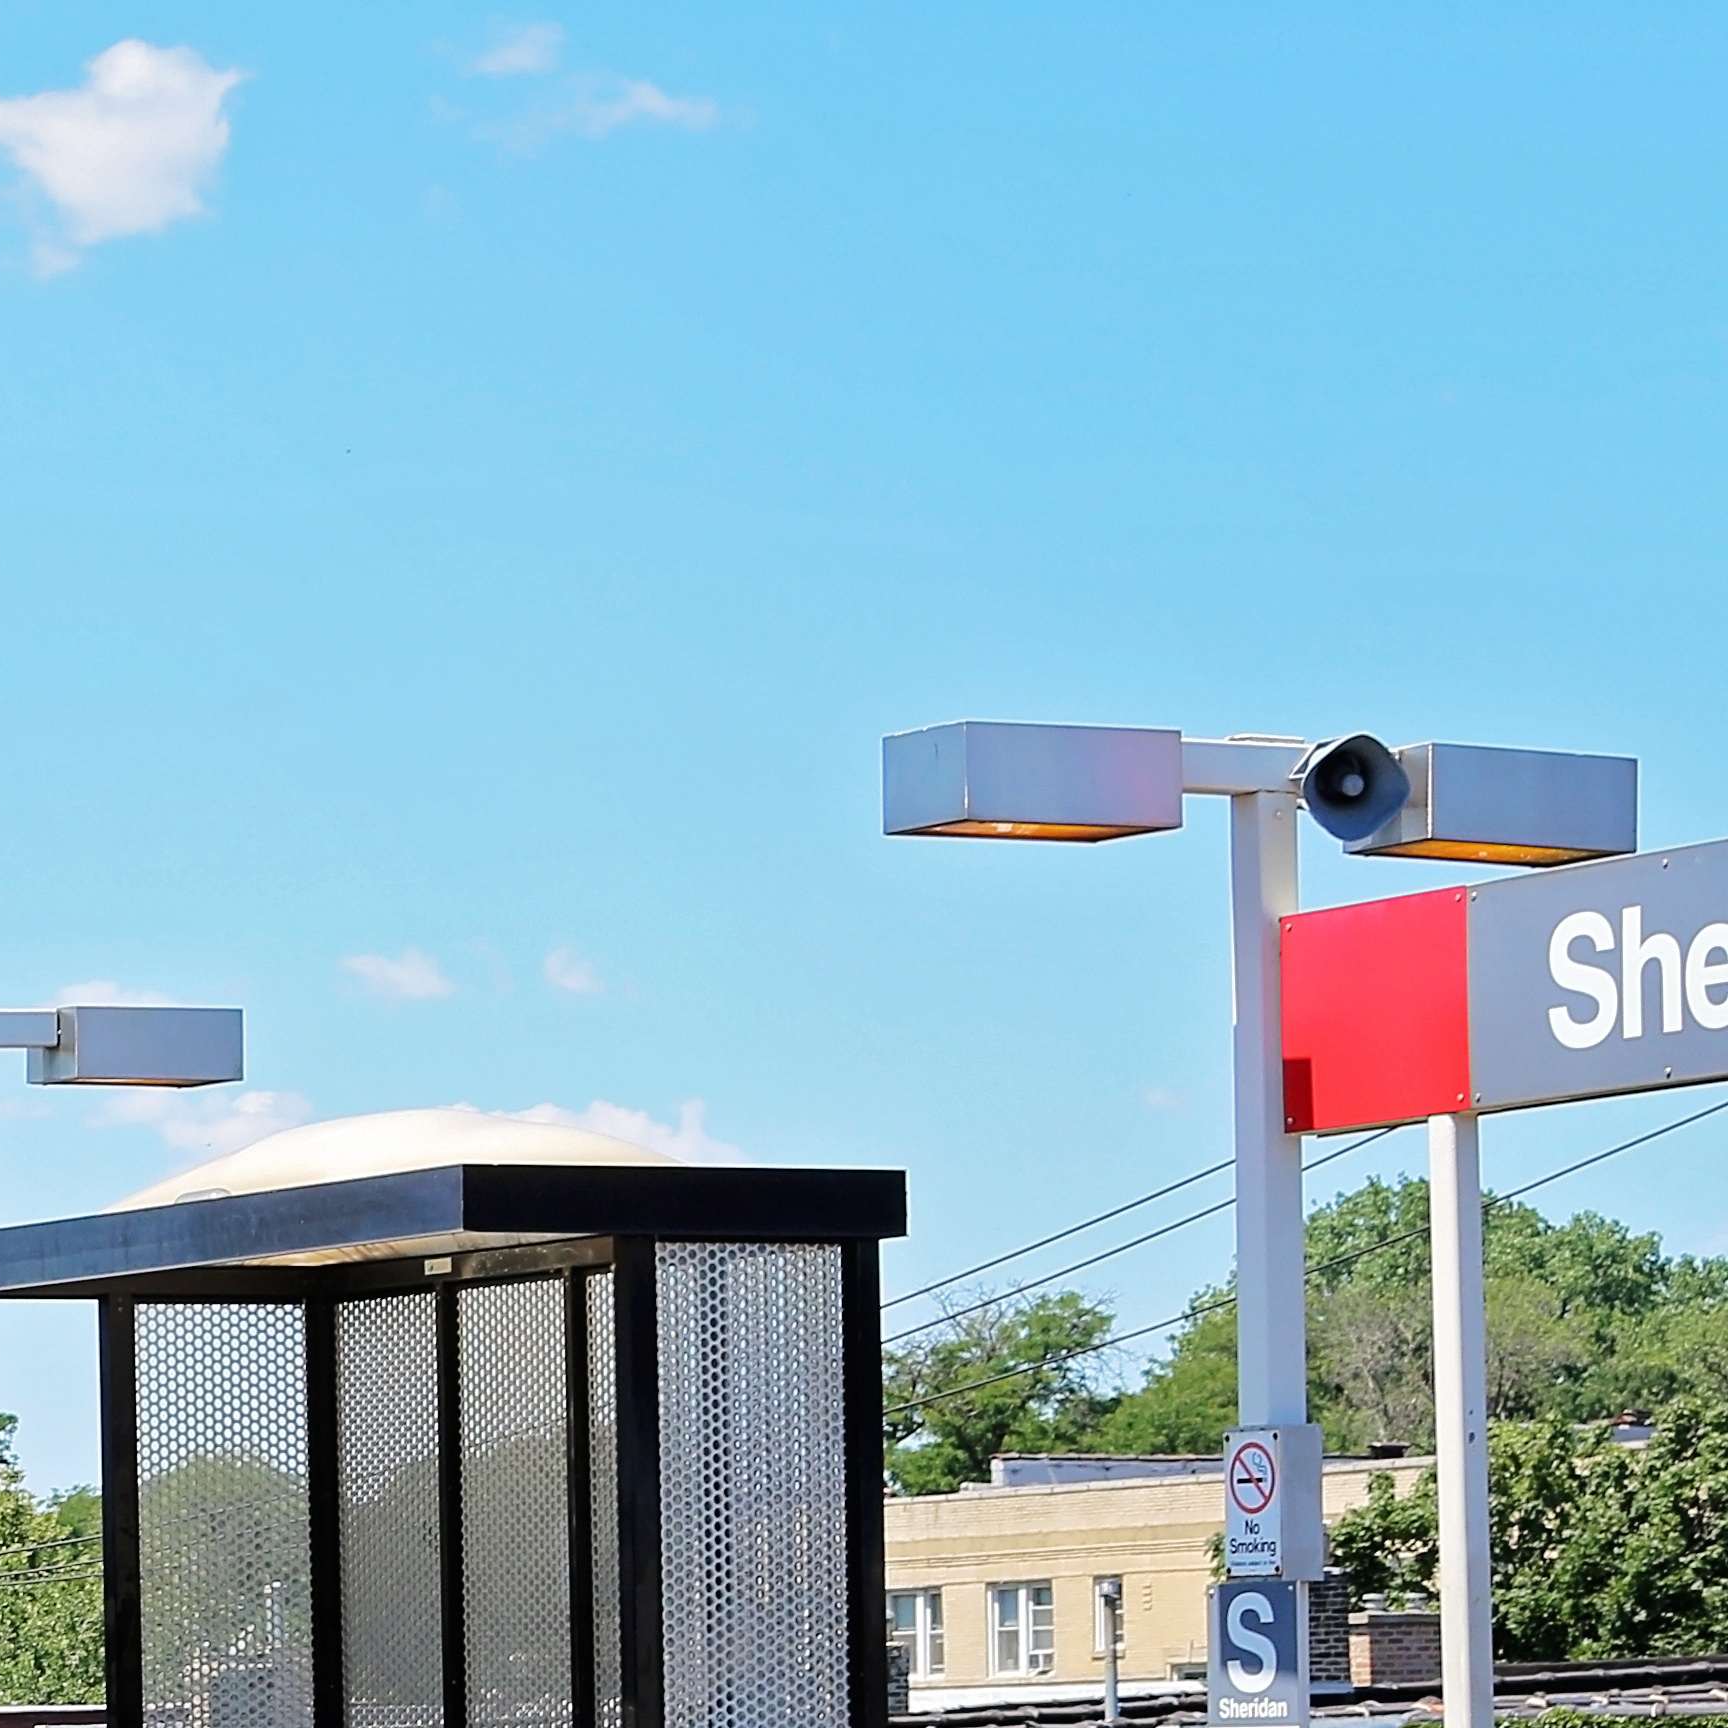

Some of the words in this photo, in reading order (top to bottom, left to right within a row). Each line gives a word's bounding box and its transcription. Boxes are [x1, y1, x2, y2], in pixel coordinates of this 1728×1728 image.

[1548, 905, 1728, 1049] She
[1244, 1518, 1260, 1536] No
[1229, 1537, 1277, 1557] Smoking
[1226, 1591, 1278, 1694] S
[1219, 1697, 1288, 1719] Sheridan
